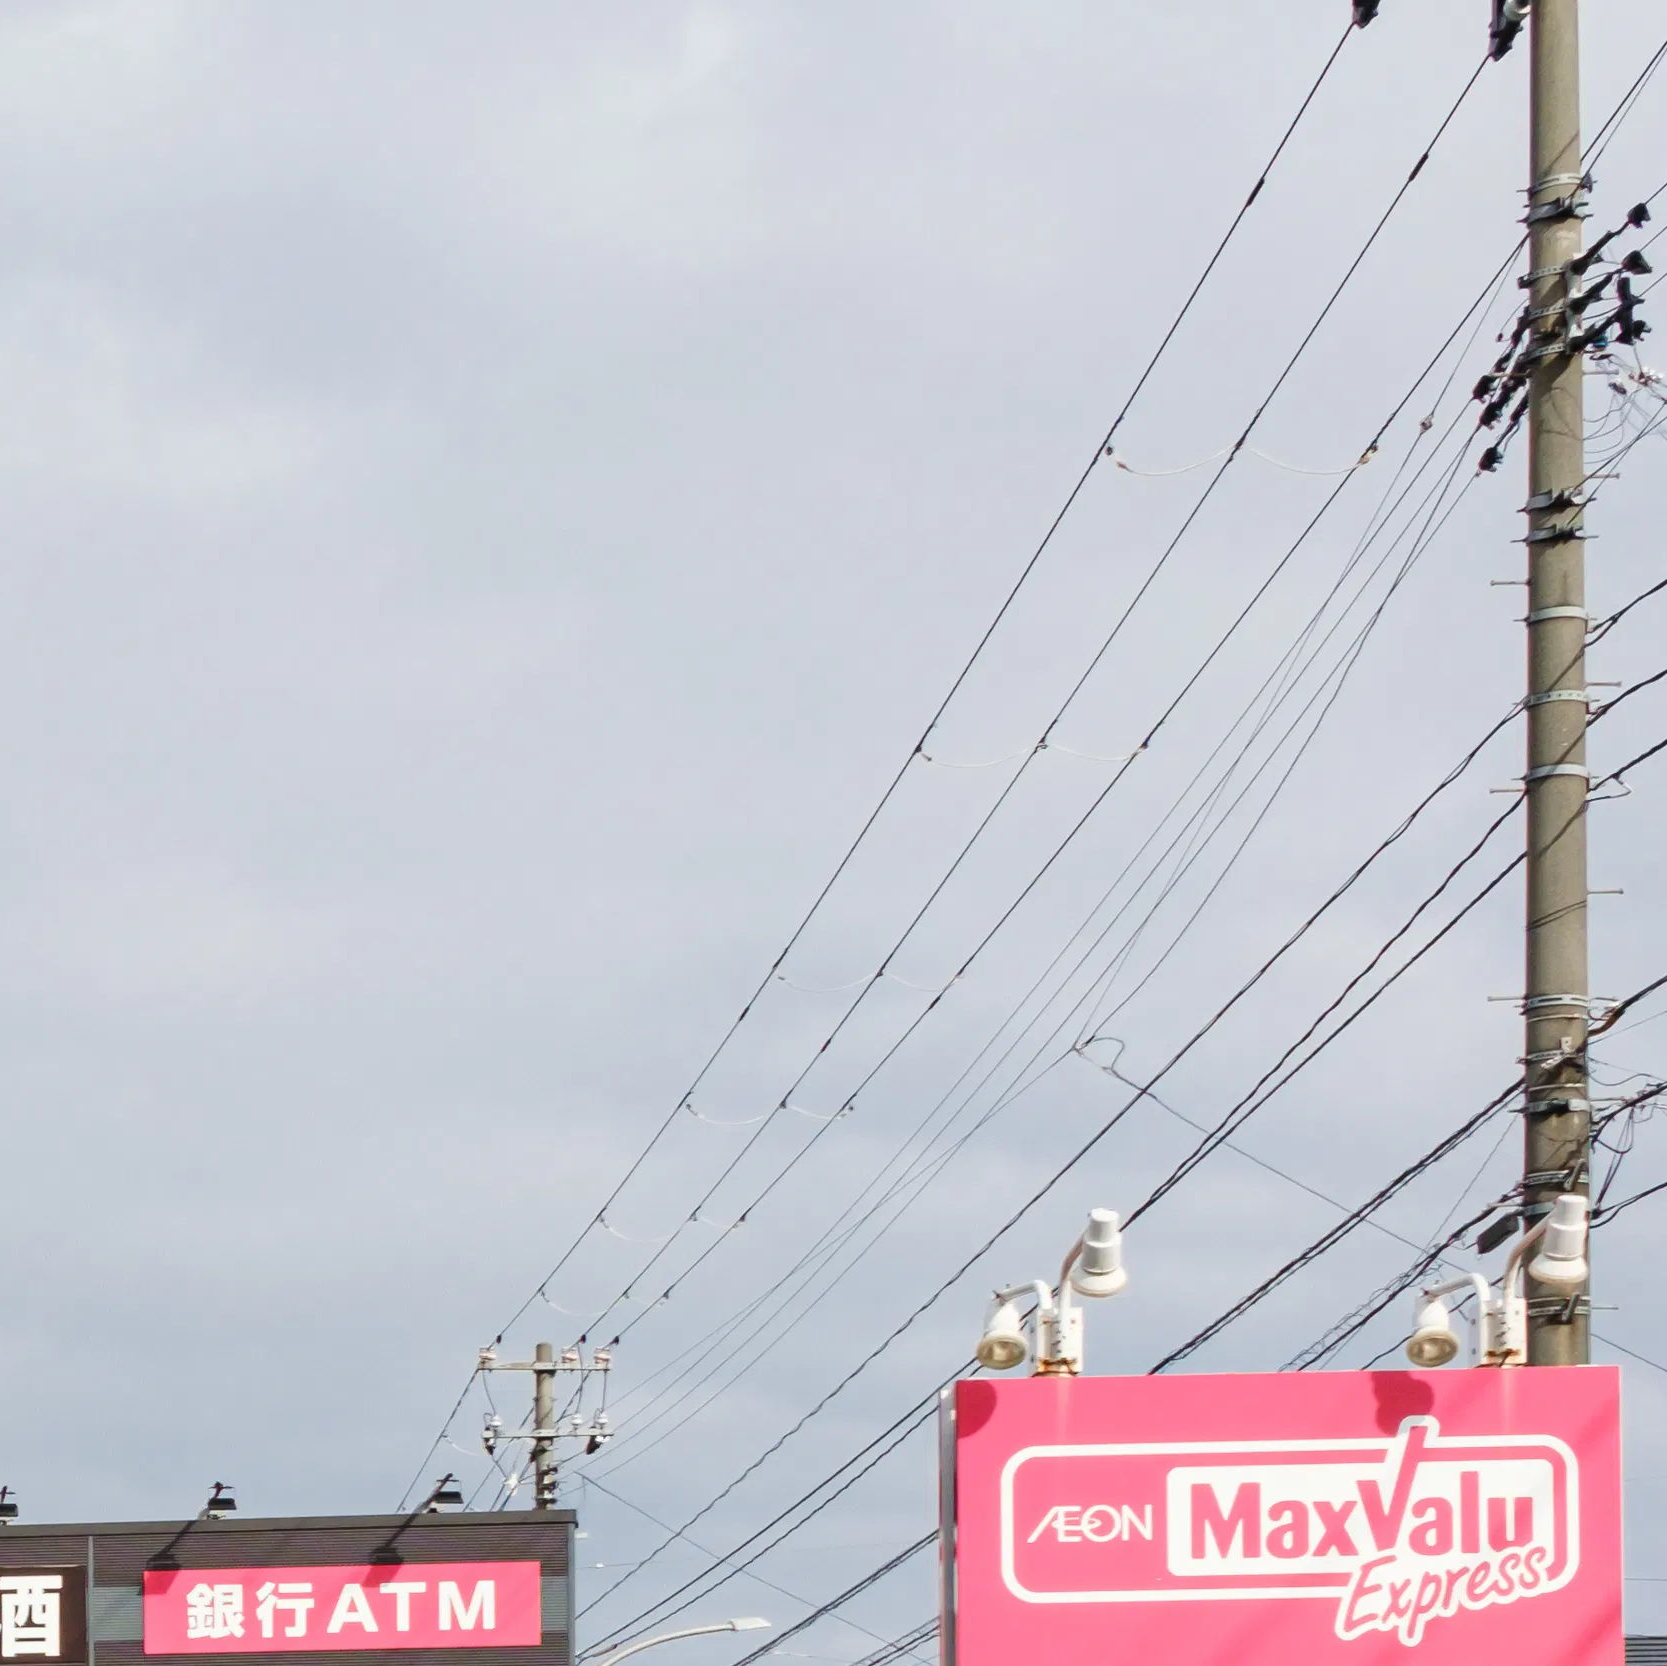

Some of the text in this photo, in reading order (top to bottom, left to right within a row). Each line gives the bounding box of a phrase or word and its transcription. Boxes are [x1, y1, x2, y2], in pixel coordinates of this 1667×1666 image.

[1191, 1426, 1534, 1560] MaxValu
[186, 1579, 496, 1640] 銀行ATM
[1344, 1545, 1547, 1639] Express
